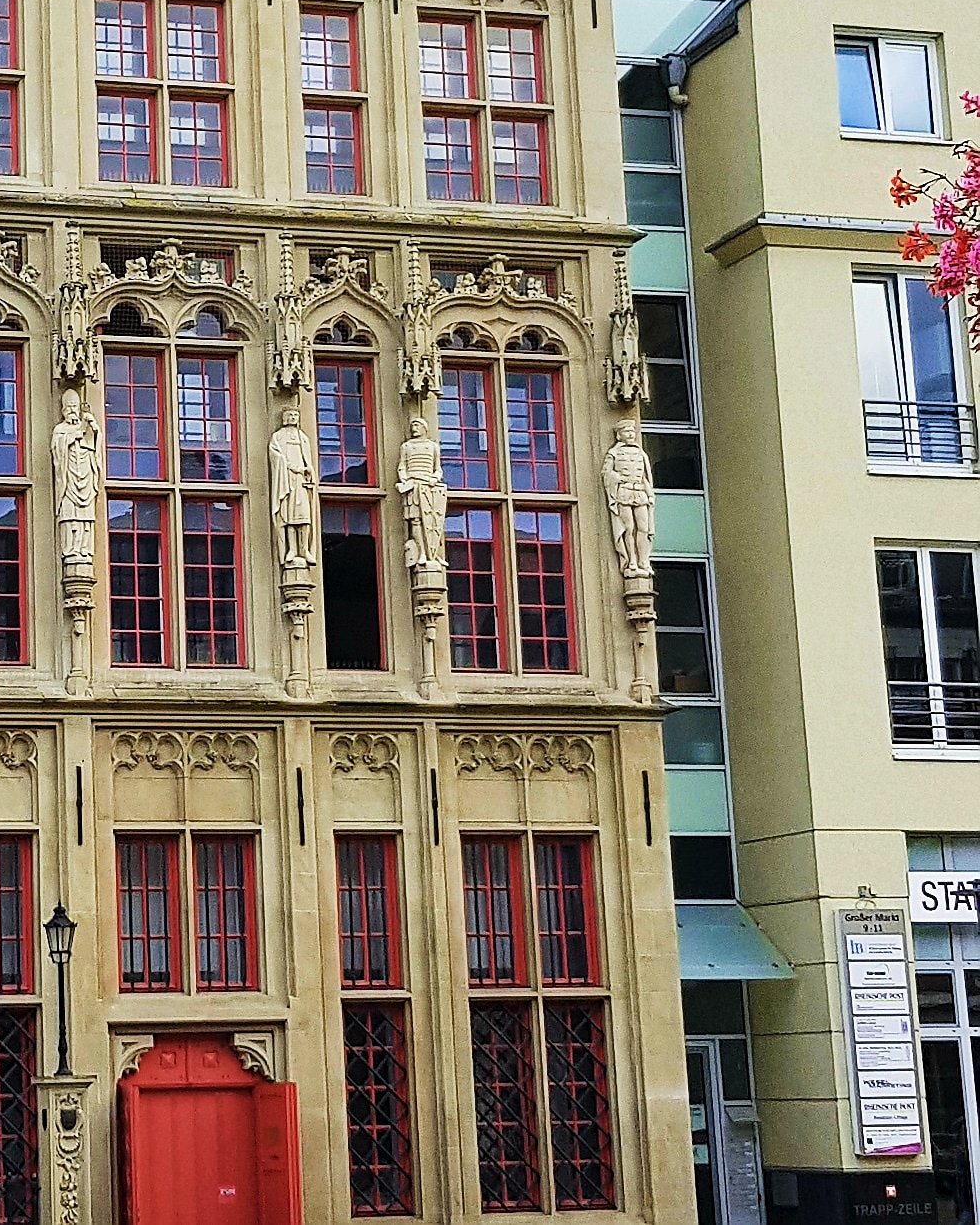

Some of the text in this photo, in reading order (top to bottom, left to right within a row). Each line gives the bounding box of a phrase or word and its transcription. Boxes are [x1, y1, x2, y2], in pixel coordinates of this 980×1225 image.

[921, 880, 978, 911] STA
[844, 913, 873, 922] Großer
[853, 1203, 932, 1216] TRAPP-ZEILE
